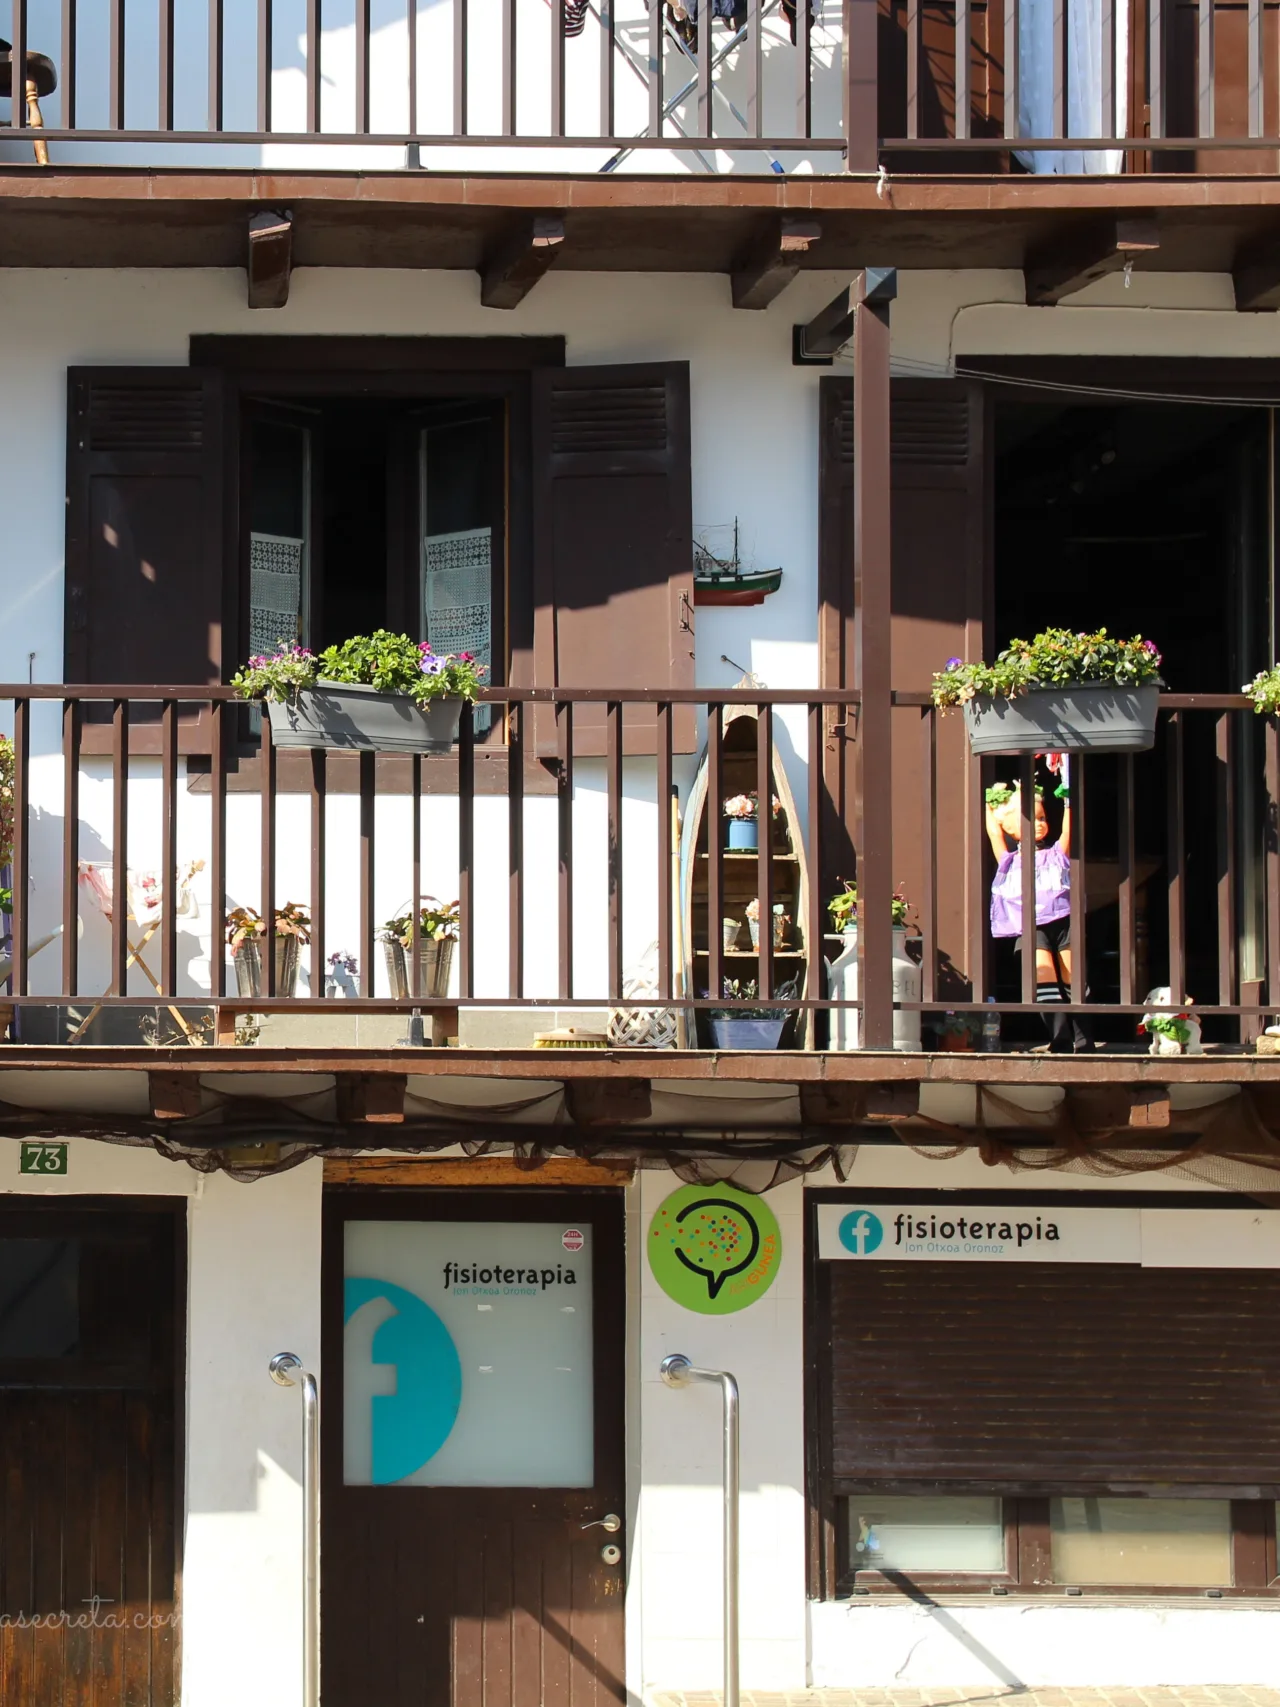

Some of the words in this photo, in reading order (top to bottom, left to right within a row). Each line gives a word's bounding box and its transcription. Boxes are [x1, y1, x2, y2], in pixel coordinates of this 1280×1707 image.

[27, 1147, 61, 1171] 73
[894, 1213, 1060, 1247] fisioterapia
[905, 1242, 923, 1253] Jon
[963, 1242, 1004, 1254] Oronoz
[443, 1262, 577, 1290] fisioterapia
